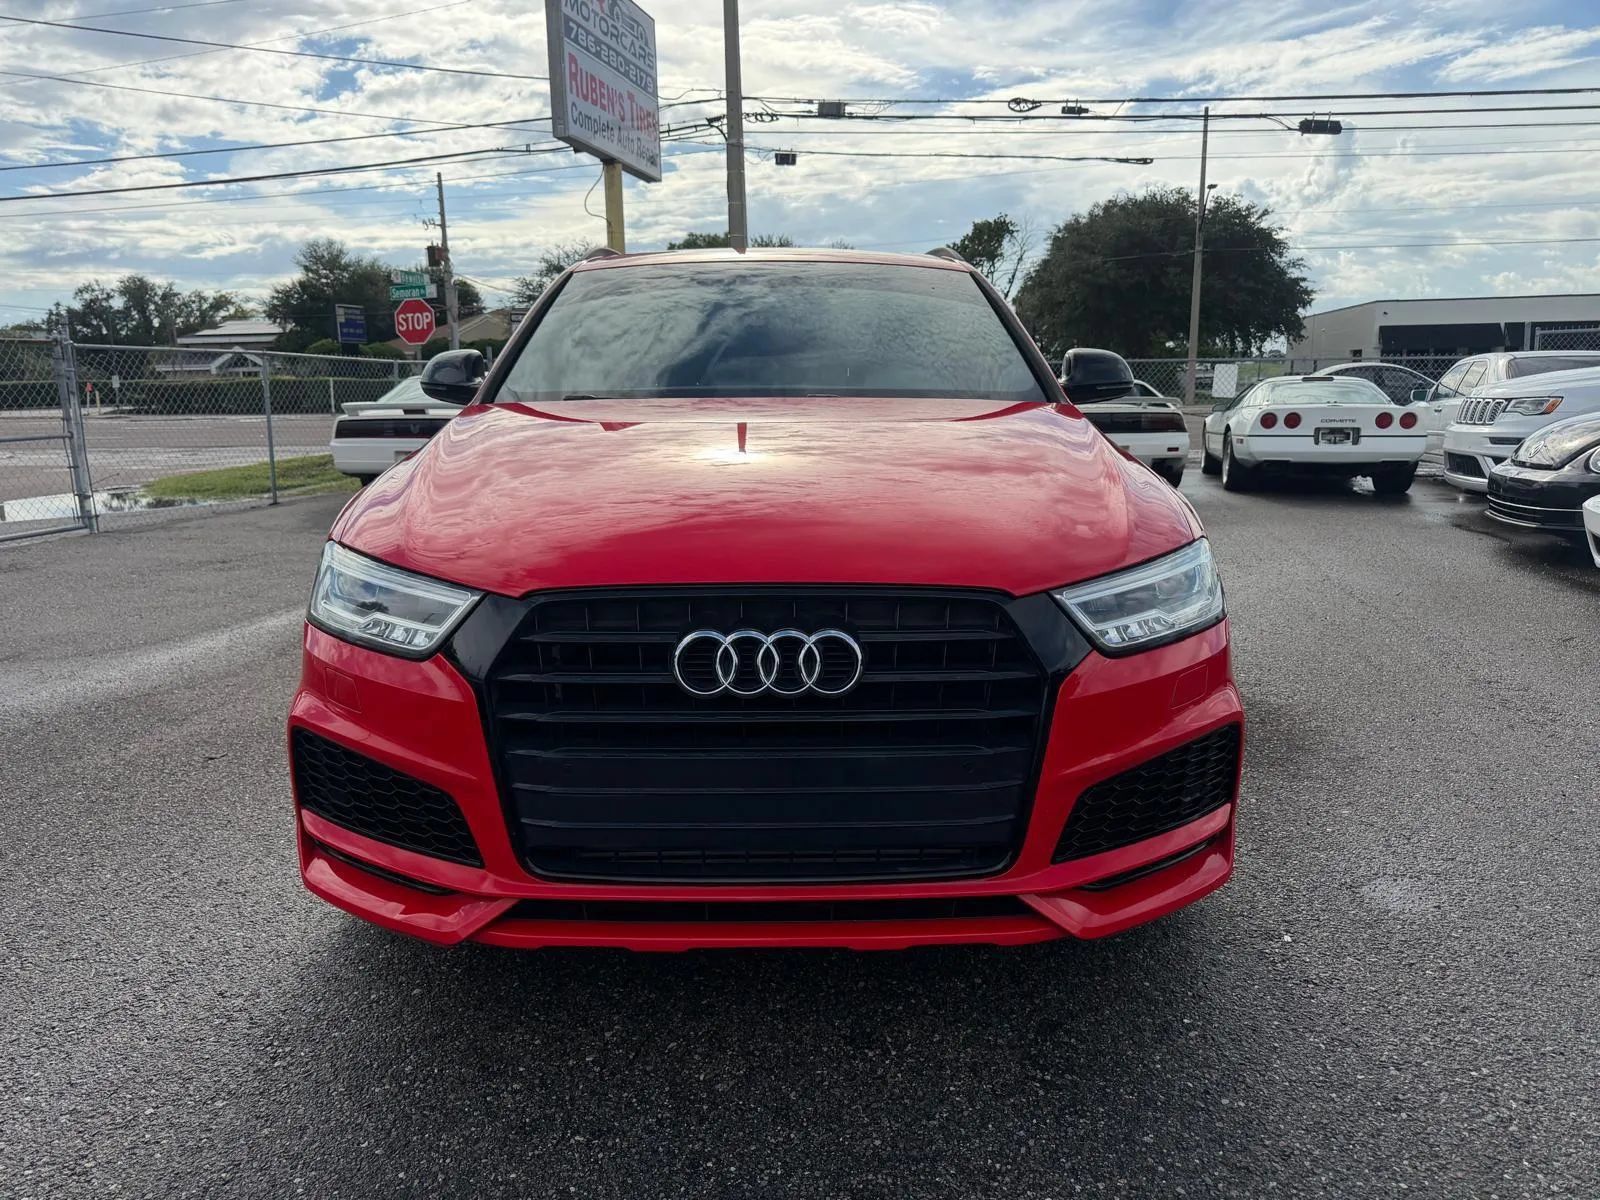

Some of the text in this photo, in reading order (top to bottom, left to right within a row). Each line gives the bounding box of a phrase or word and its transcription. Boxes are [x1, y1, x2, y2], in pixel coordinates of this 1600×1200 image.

[564, 0, 654, 70] MOTORCARS
[568, 21, 654, 93] 786-280-2179
[568, 53, 625, 122] RUBEN'S
[571, 101, 615, 143] Complete
[398, 312, 431, 331] STOP
